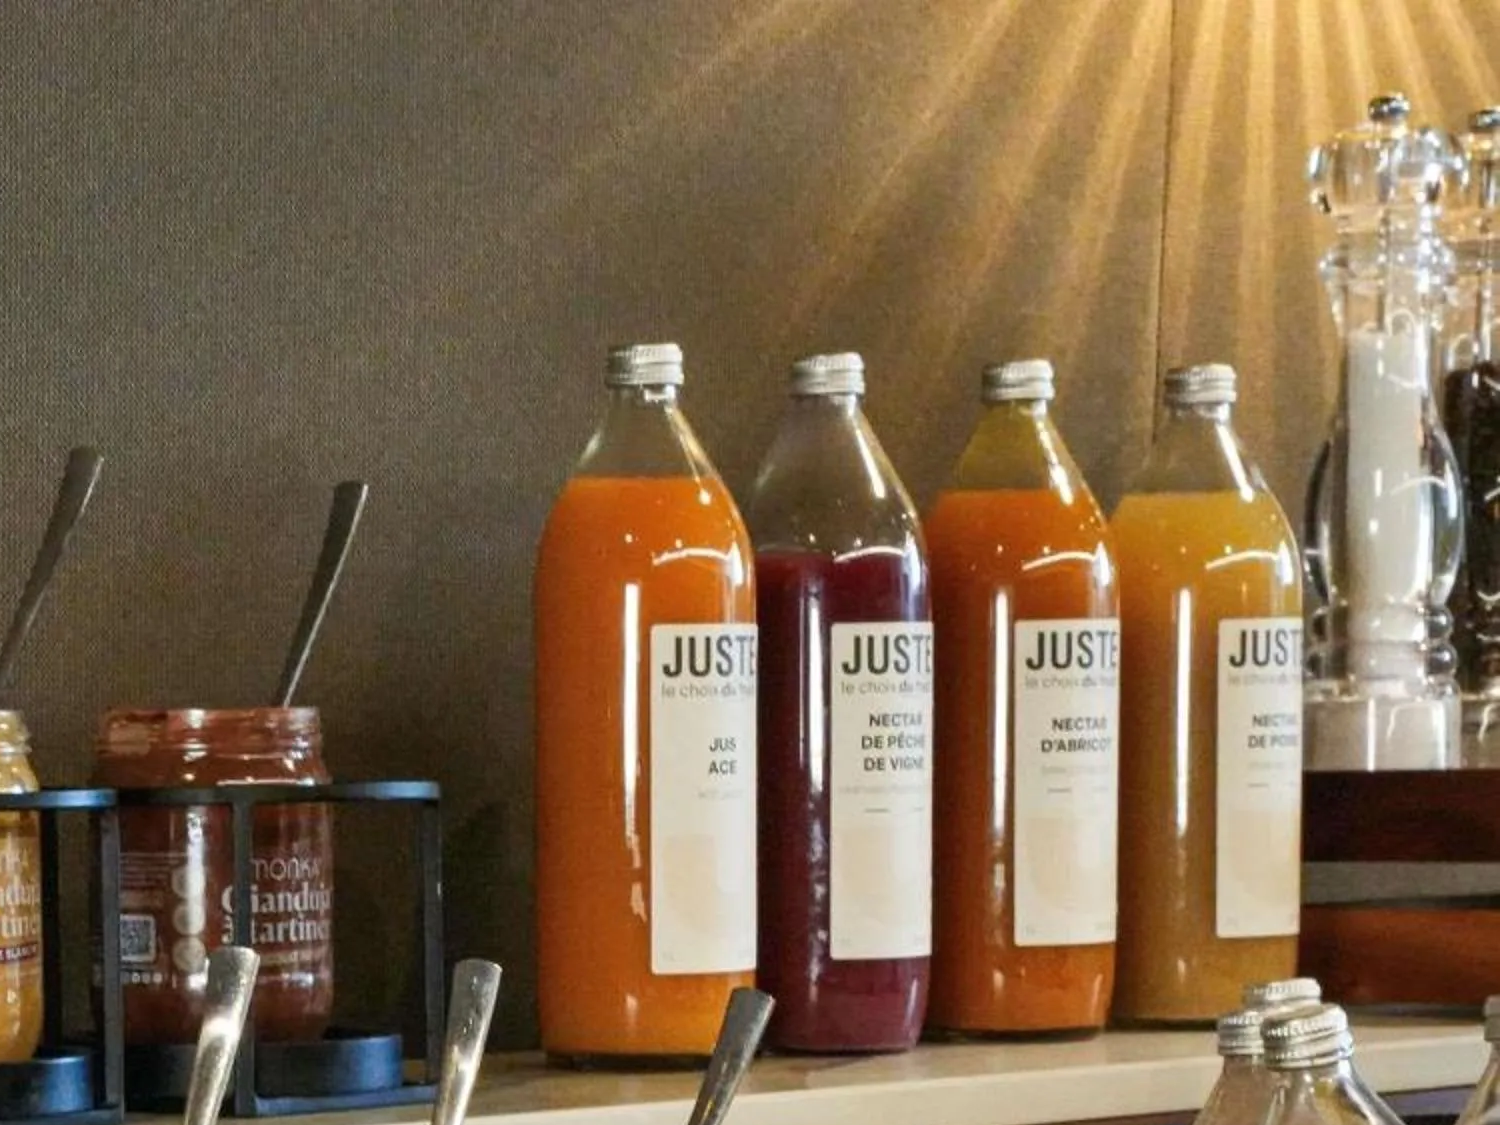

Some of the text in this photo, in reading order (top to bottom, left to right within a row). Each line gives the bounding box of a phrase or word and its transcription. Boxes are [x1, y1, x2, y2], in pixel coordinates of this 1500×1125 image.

[1229, 629, 1302, 668] JUST
[709, 737, 736, 753] JUS
[862, 735, 884, 749] DE
[1248, 735, 1265, 749] DE
[709, 759, 738, 775] ACE
[864, 757, 885, 771] DE
